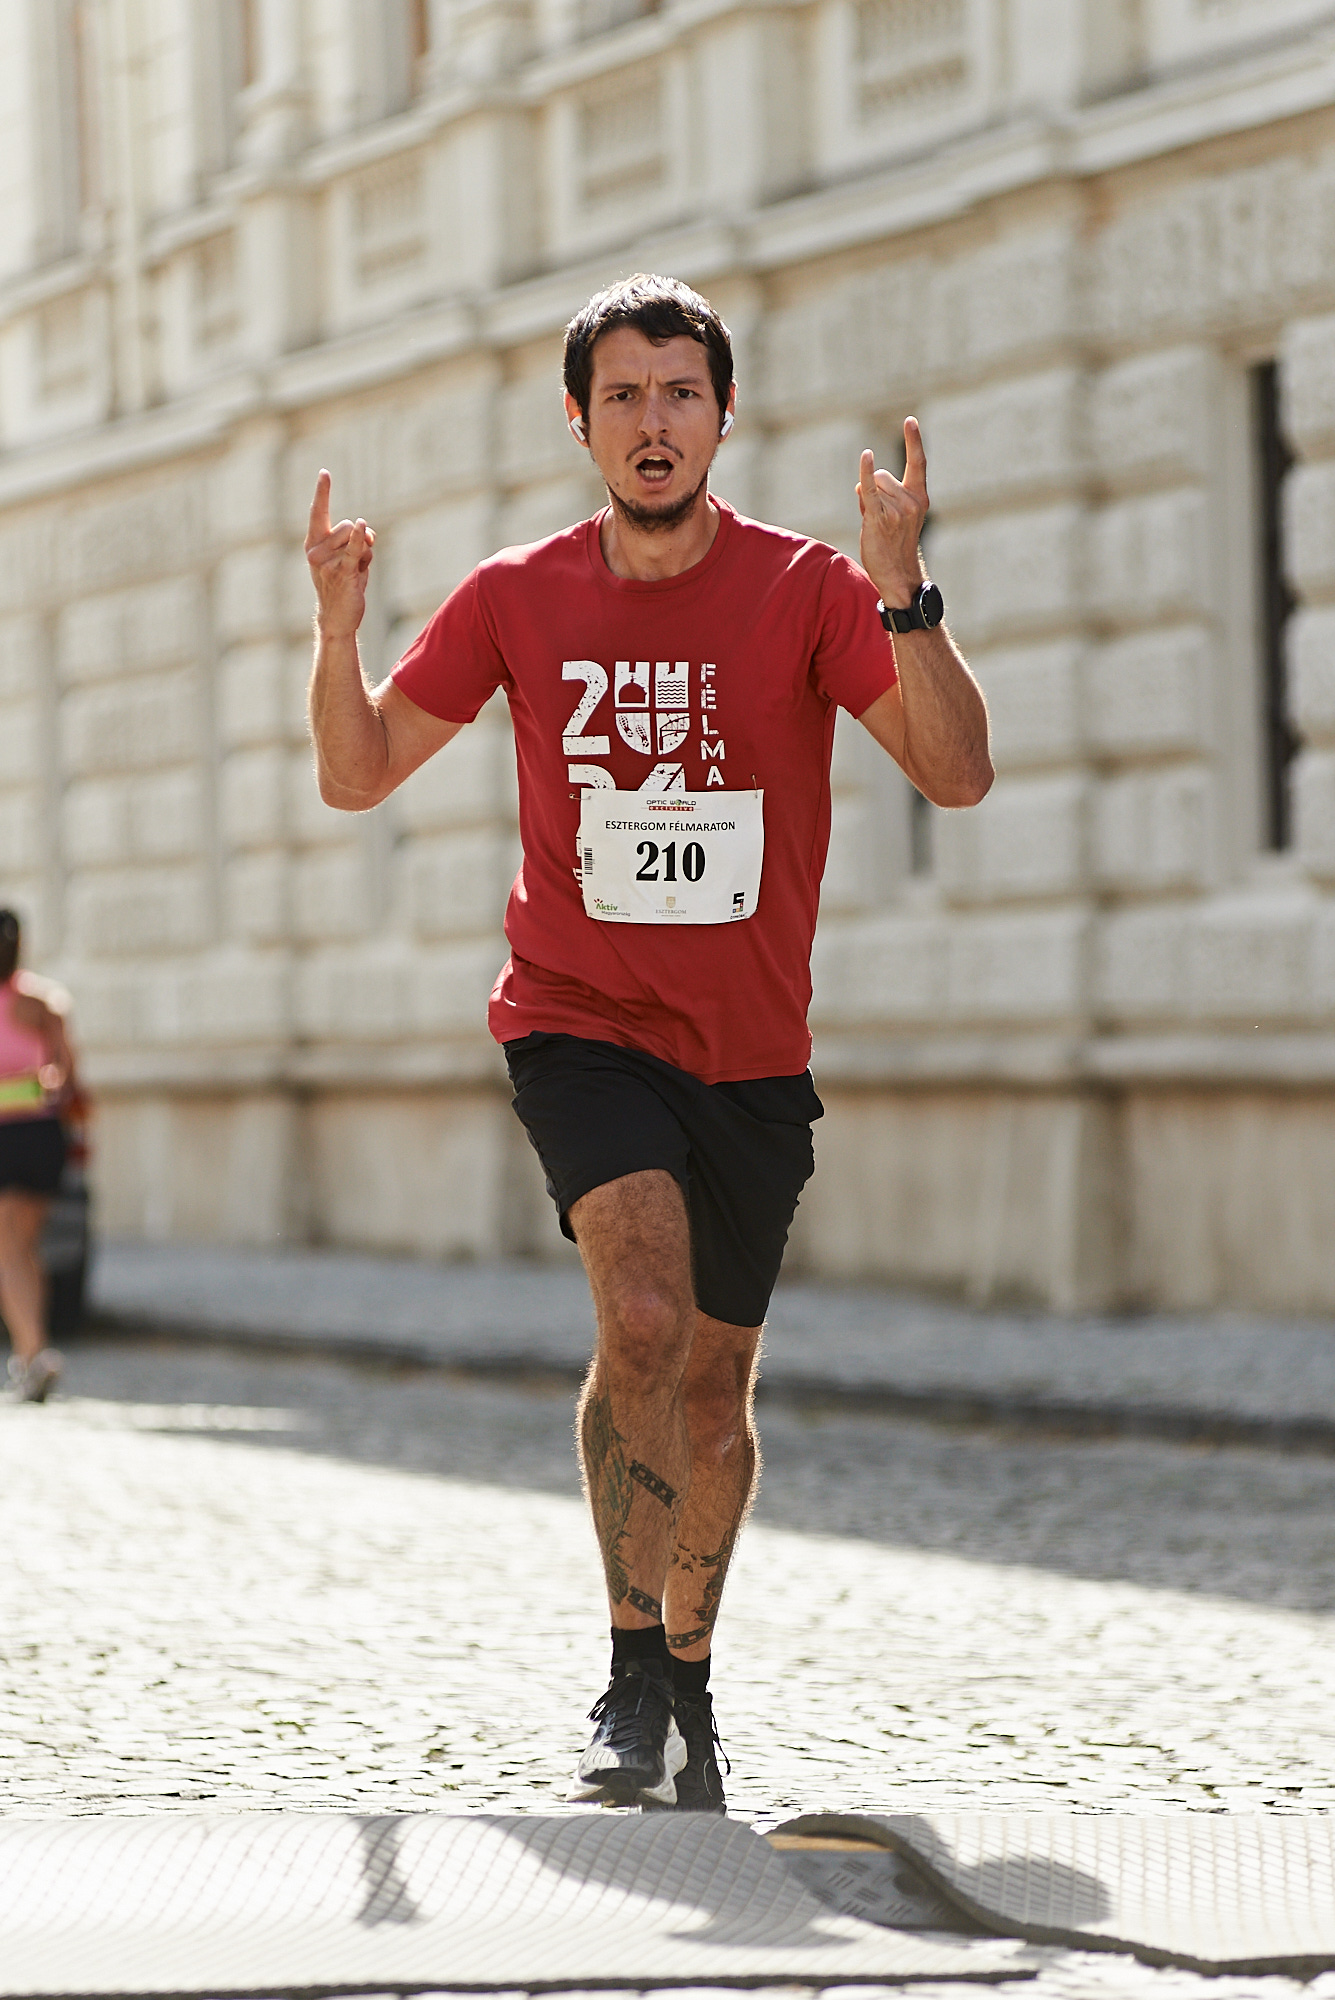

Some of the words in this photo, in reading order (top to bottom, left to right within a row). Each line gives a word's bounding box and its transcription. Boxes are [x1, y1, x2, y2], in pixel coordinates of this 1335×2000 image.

[605, 820, 666, 831] ESZTERGOM
[669, 820, 735, 832] FÉLMARATON
[636, 841, 706, 882] 210
